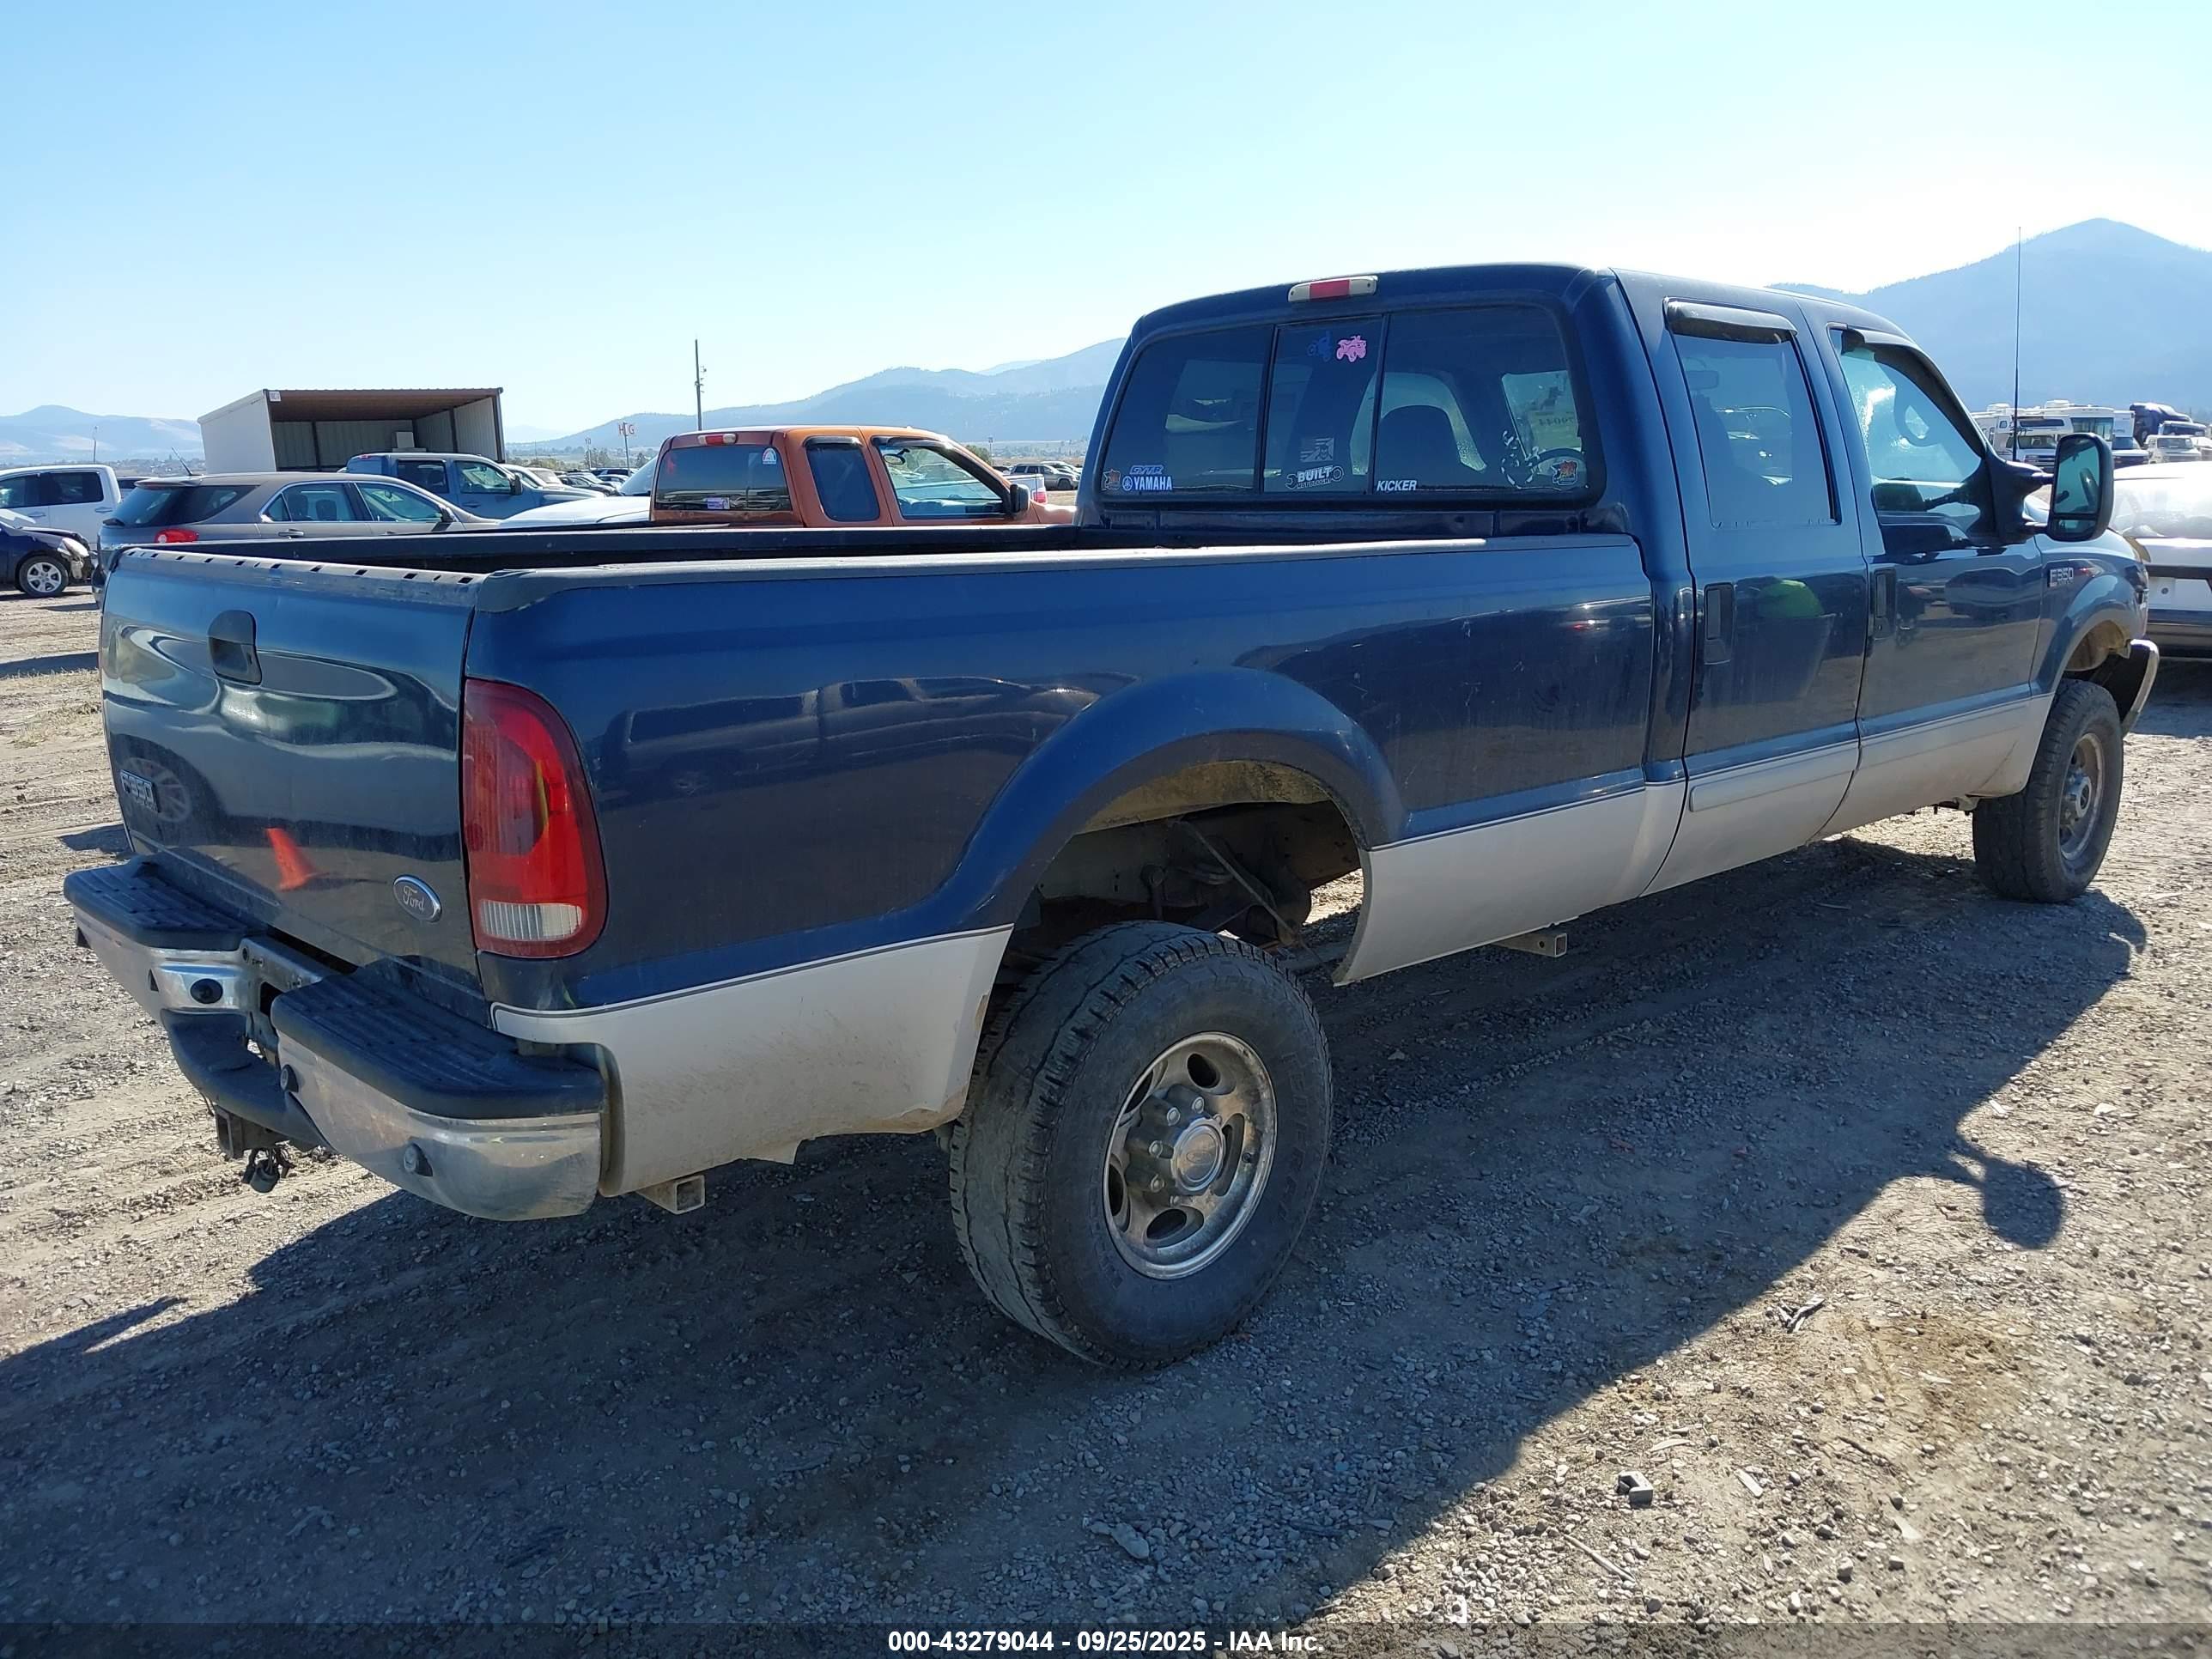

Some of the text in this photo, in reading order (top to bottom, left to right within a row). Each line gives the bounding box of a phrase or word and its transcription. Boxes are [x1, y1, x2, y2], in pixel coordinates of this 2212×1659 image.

[1297, 465, 1333, 483] BUILT
[1133, 475, 1173, 491] YAMAHA
[1376, 479, 1418, 492] KICKER
[403, 885, 425, 912] Ford
